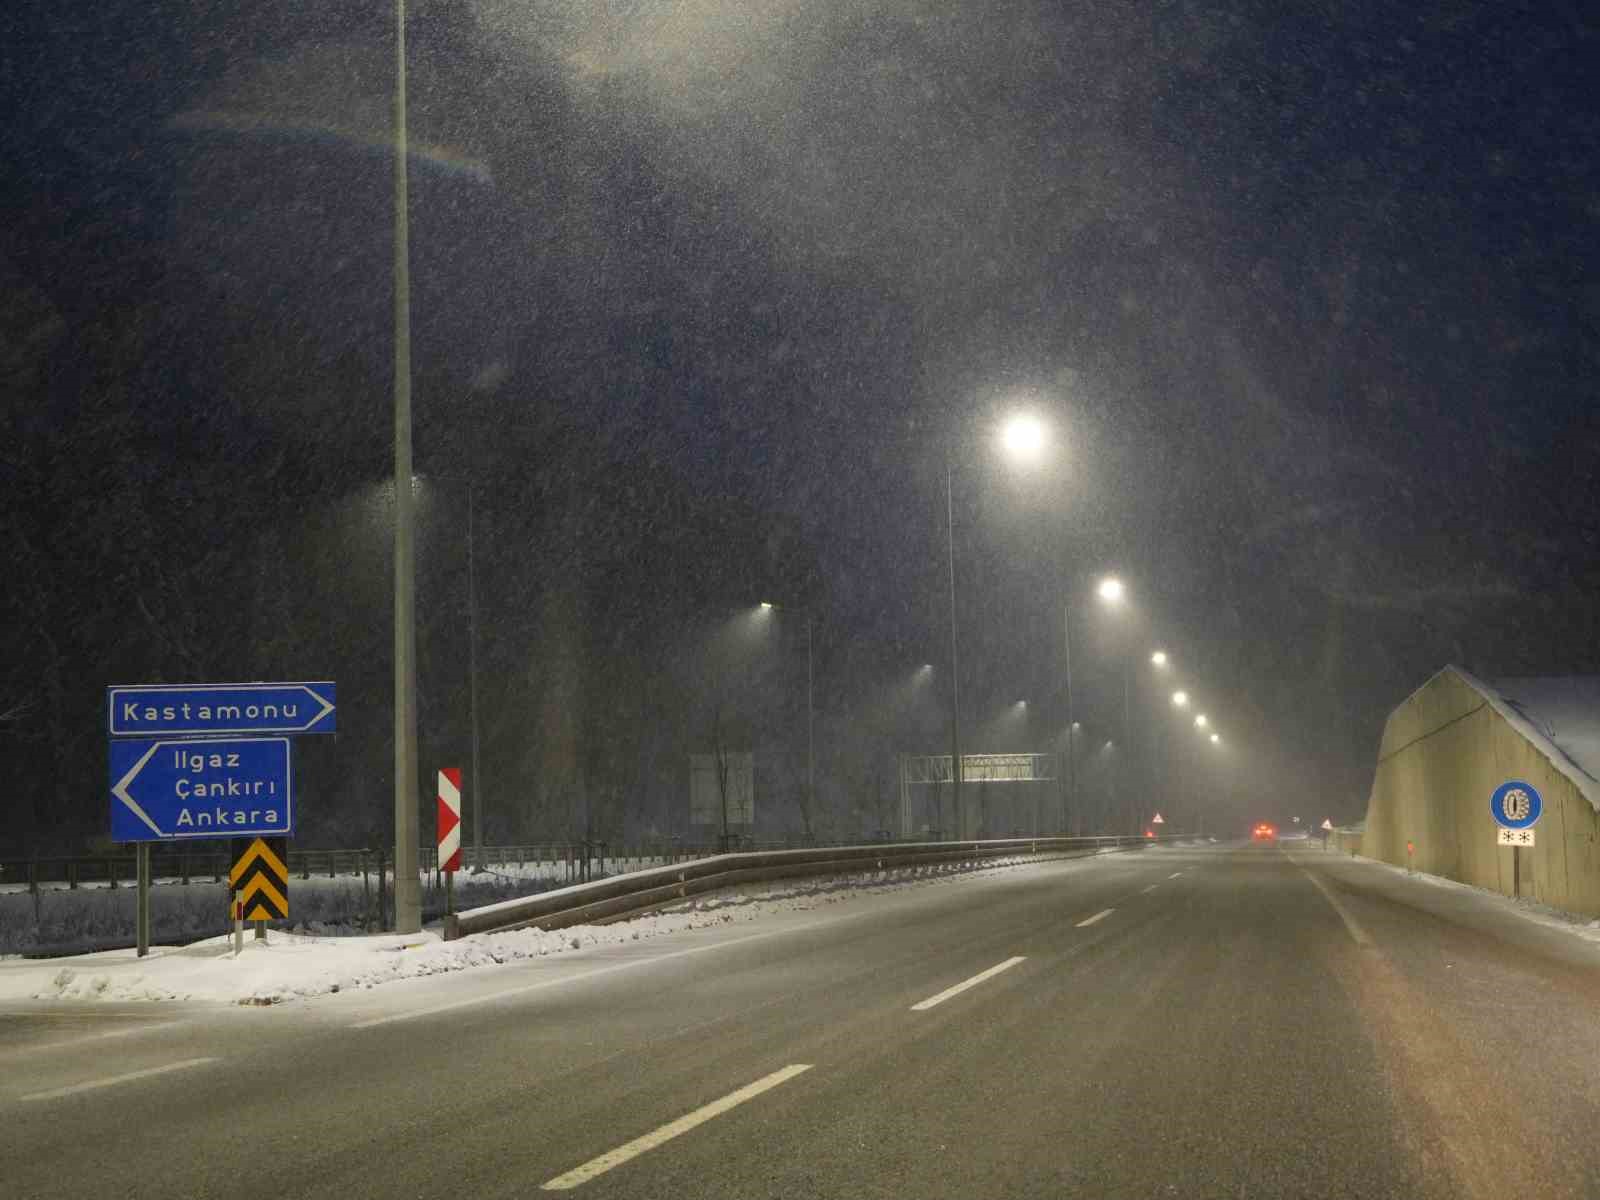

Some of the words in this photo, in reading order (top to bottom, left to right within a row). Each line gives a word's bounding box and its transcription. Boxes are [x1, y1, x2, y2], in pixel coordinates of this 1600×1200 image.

[123, 702, 297, 721] Kastamonu
[174, 750, 240, 773] Ilgaz
[175, 778, 275, 800] Çankırı
[176, 807, 279, 826] Ankara
